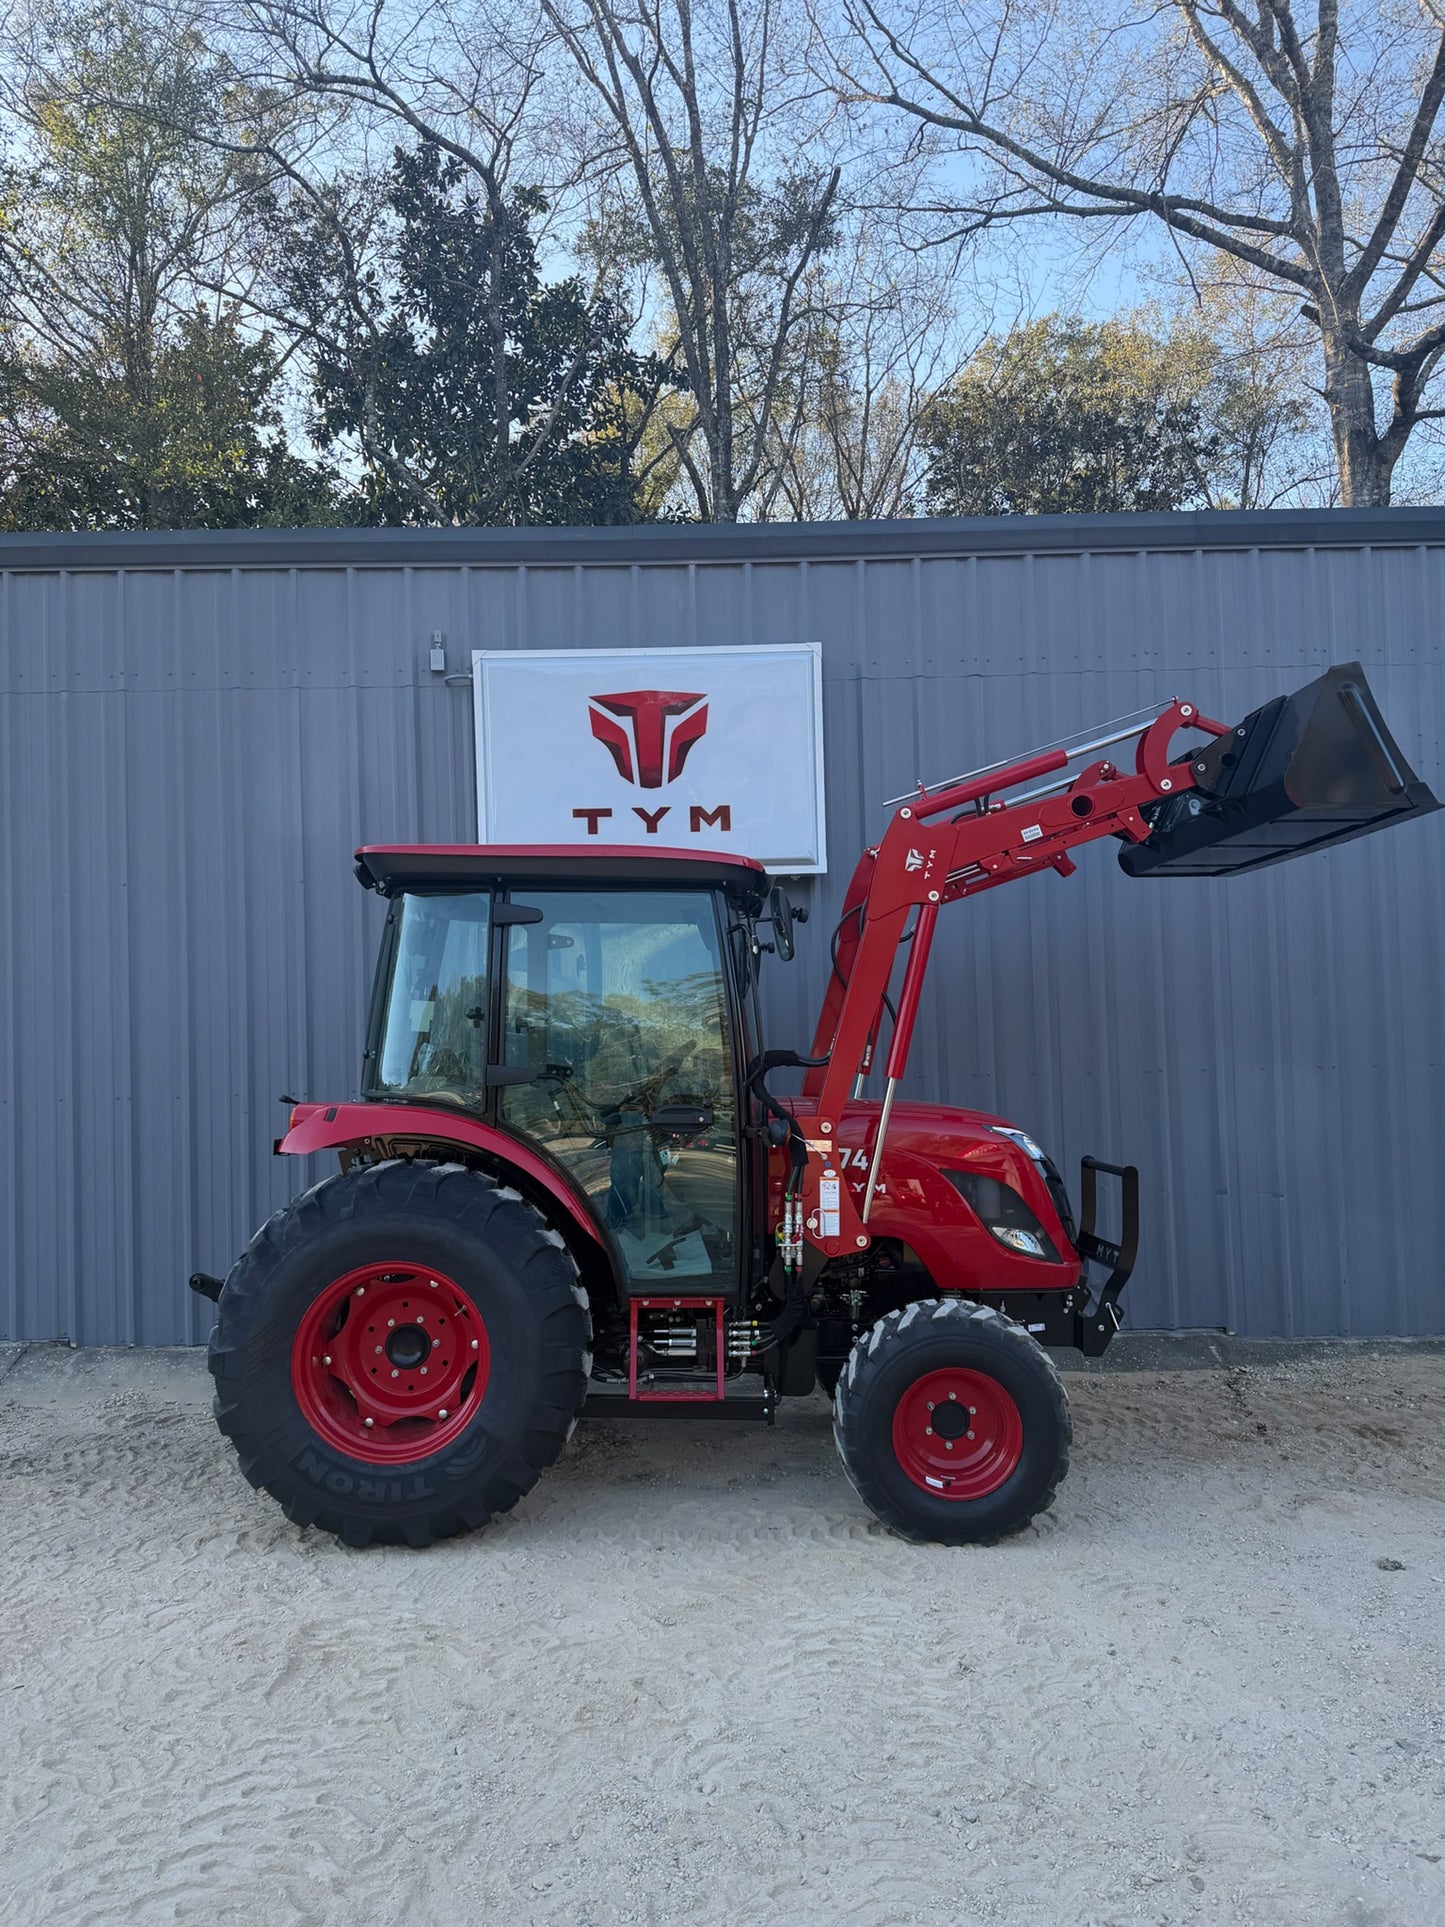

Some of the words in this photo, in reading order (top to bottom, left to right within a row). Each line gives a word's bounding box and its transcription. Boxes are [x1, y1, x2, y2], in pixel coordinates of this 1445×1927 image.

[572, 805, 731, 835] TYM
[924, 849, 937, 880] TYM
[297, 1451, 436, 1502] TIRON
